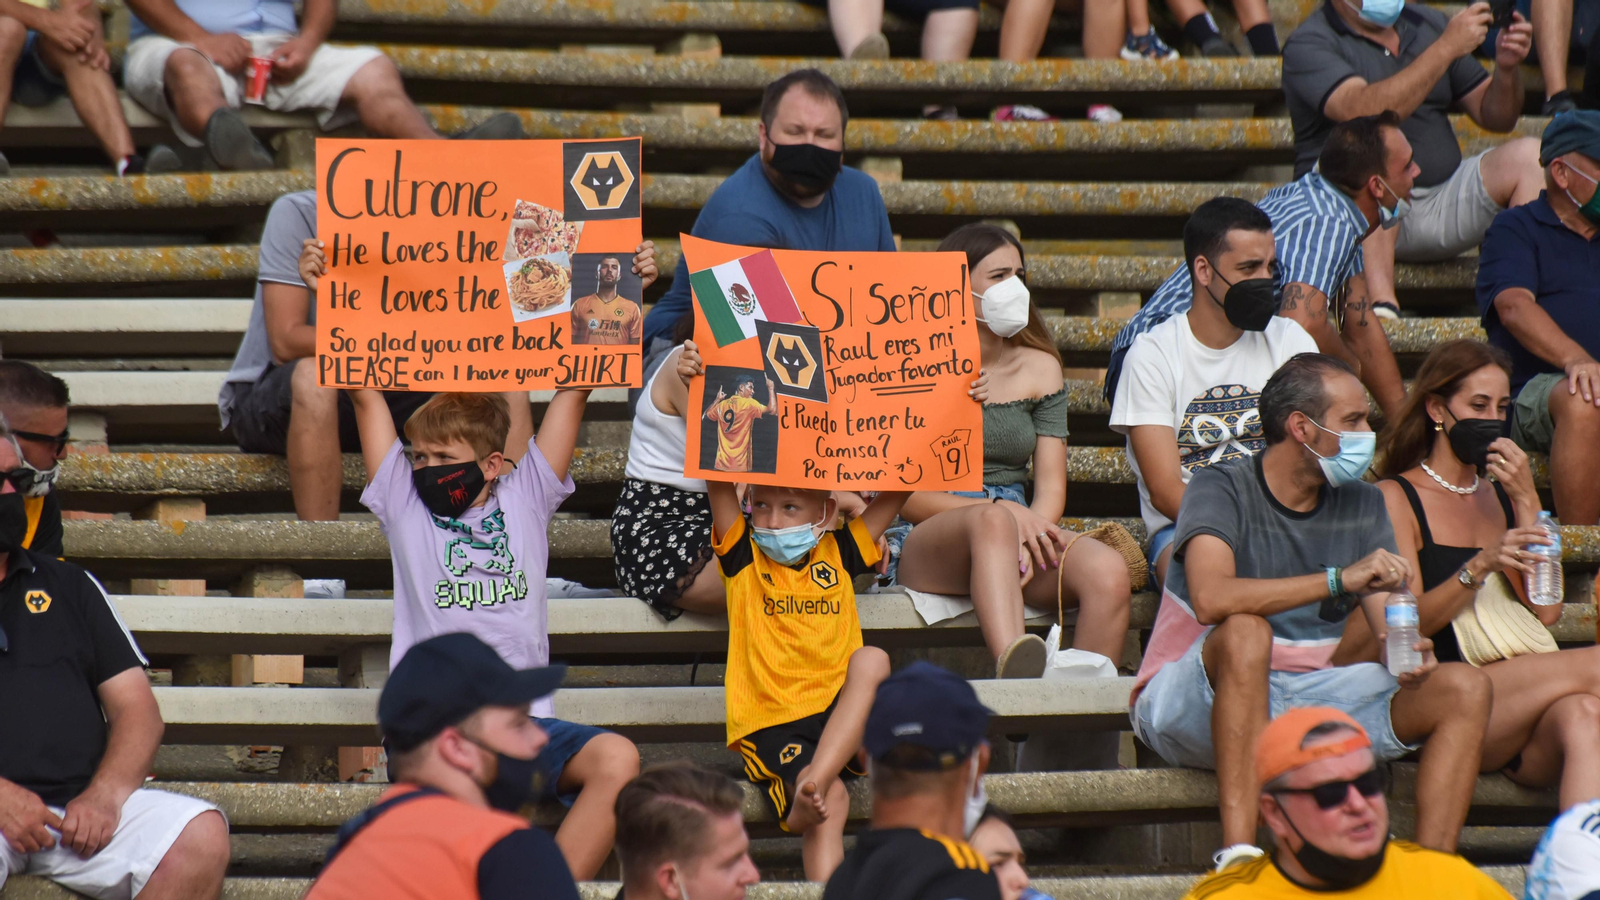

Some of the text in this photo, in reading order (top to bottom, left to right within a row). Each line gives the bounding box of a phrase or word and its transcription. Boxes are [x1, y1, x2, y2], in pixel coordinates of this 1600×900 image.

[325, 147, 508, 222] Cutrone,
[331, 232, 369, 268] He
[456, 230, 499, 264] the
[330, 281, 362, 310] He
[453, 275, 502, 313] the
[866, 263, 968, 326] Señor!
[330, 321, 564, 364] So glad you are back
[824, 325, 954, 366] Raul eres mi
[318, 354, 409, 388] PLEASE
[413, 369, 445, 382] can
[467, 364, 509, 381] have
[514, 365, 554, 386] your
[825, 348, 974, 404] Jugador favorito
[723, 408, 735, 432] 9
[780, 400, 927, 436] ¿Puedo tener tu
[815, 433, 892, 459] Camisa?
[941, 434, 962, 448] RAUL
[802, 458, 829, 479] Por
[945, 447, 961, 475] 9
[434, 570, 529, 611] SQUAD
